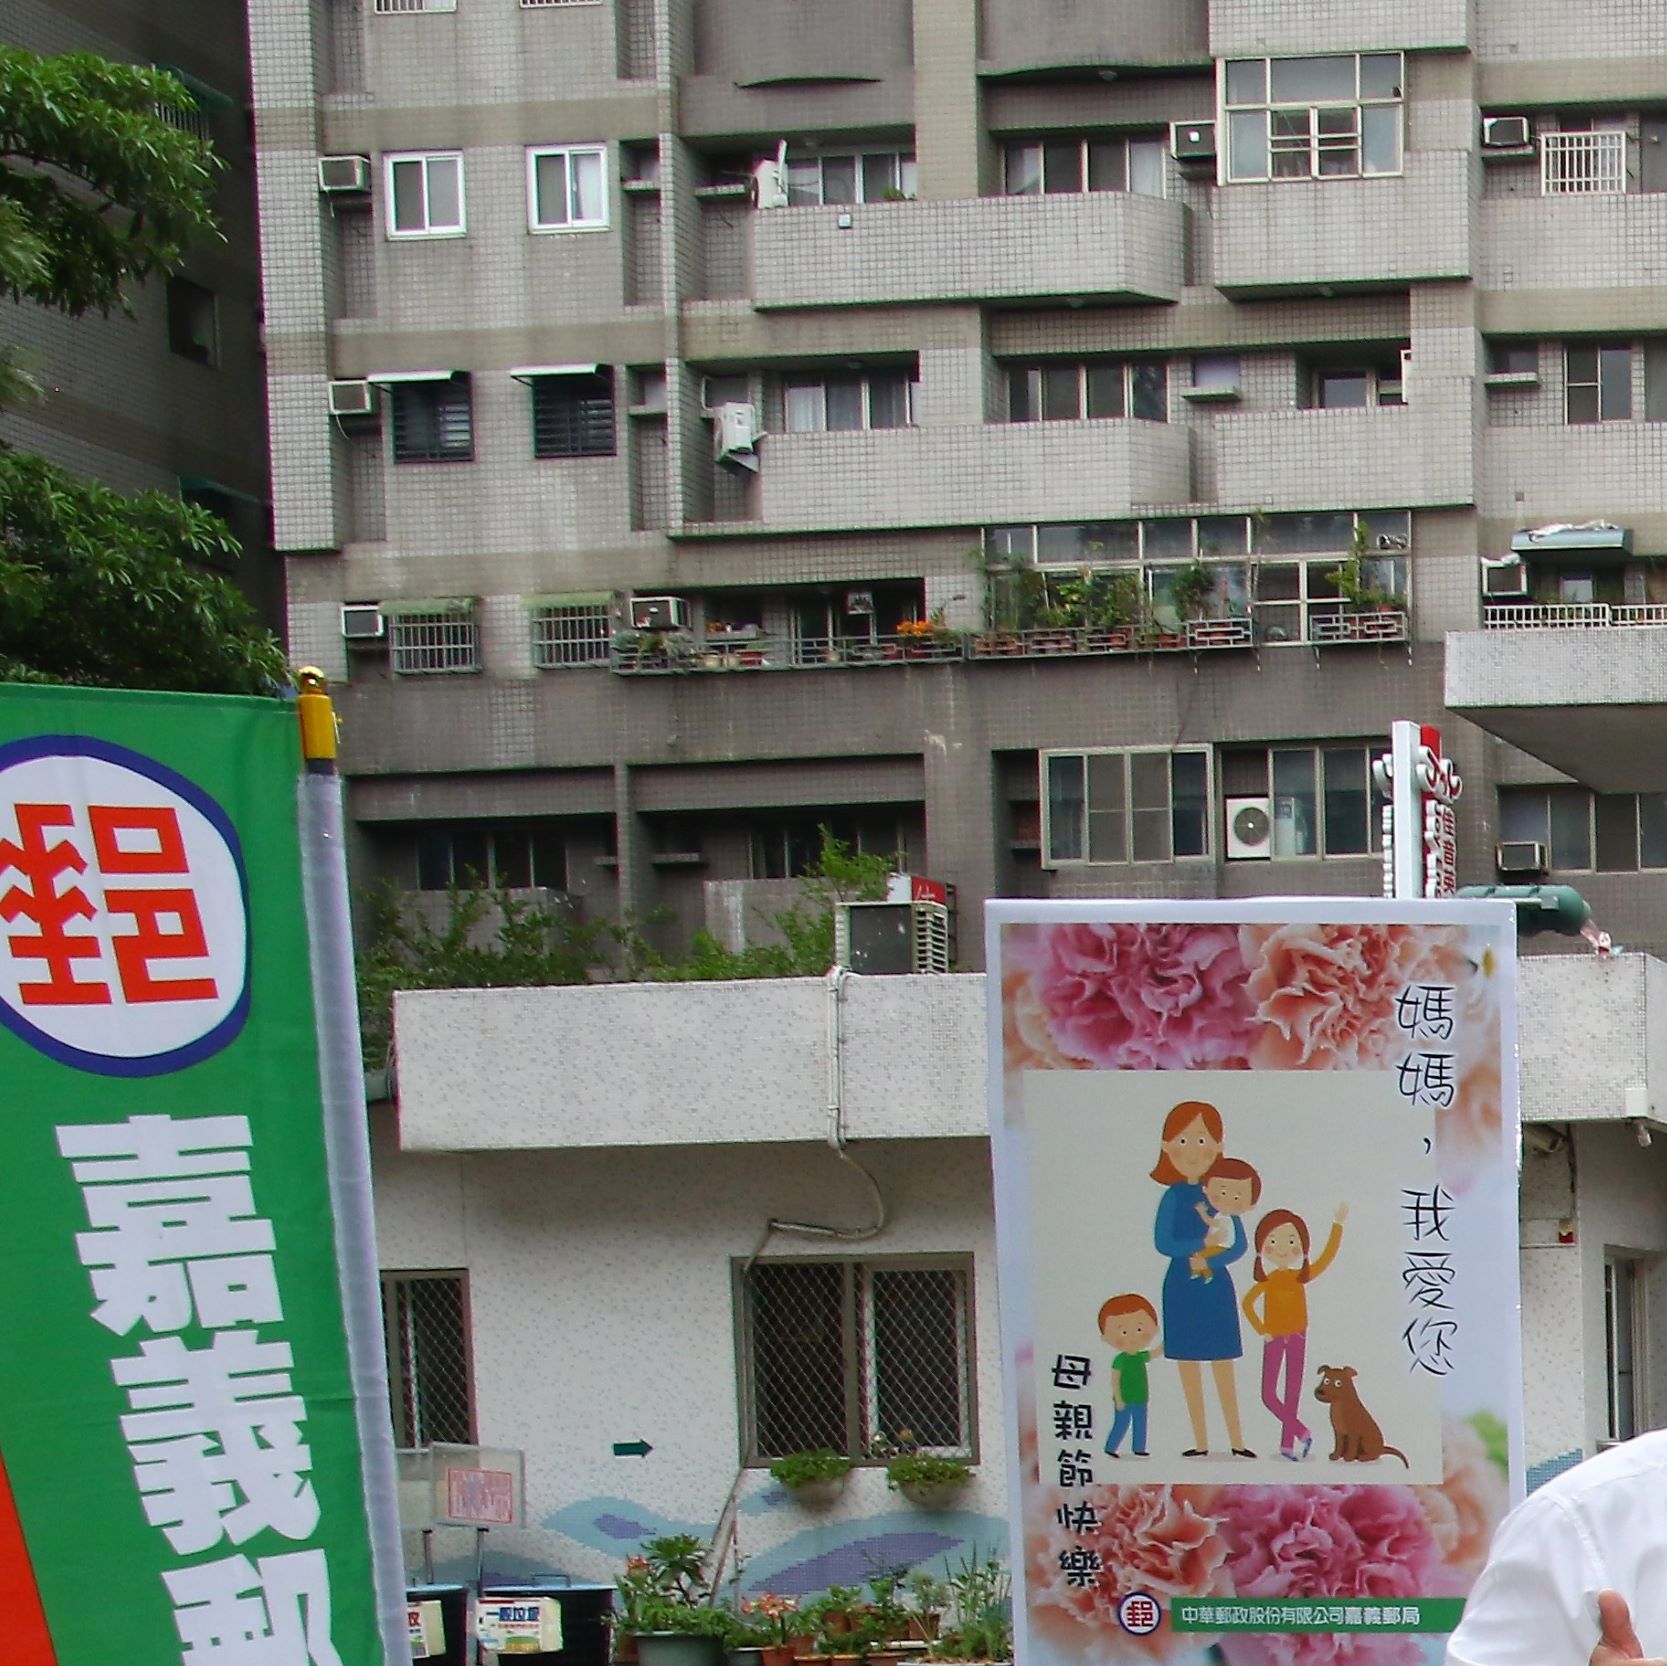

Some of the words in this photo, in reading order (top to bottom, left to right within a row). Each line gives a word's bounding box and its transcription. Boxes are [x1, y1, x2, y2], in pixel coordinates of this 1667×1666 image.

[0, 803, 218, 1006] 郵
[1050, 1353, 1104, 1590] 母親節快樂
[1125, 1600, 1155, 1628] 郵
[1182, 1606, 1421, 1626] 中華郵政股份有限公司嘉義郵局
